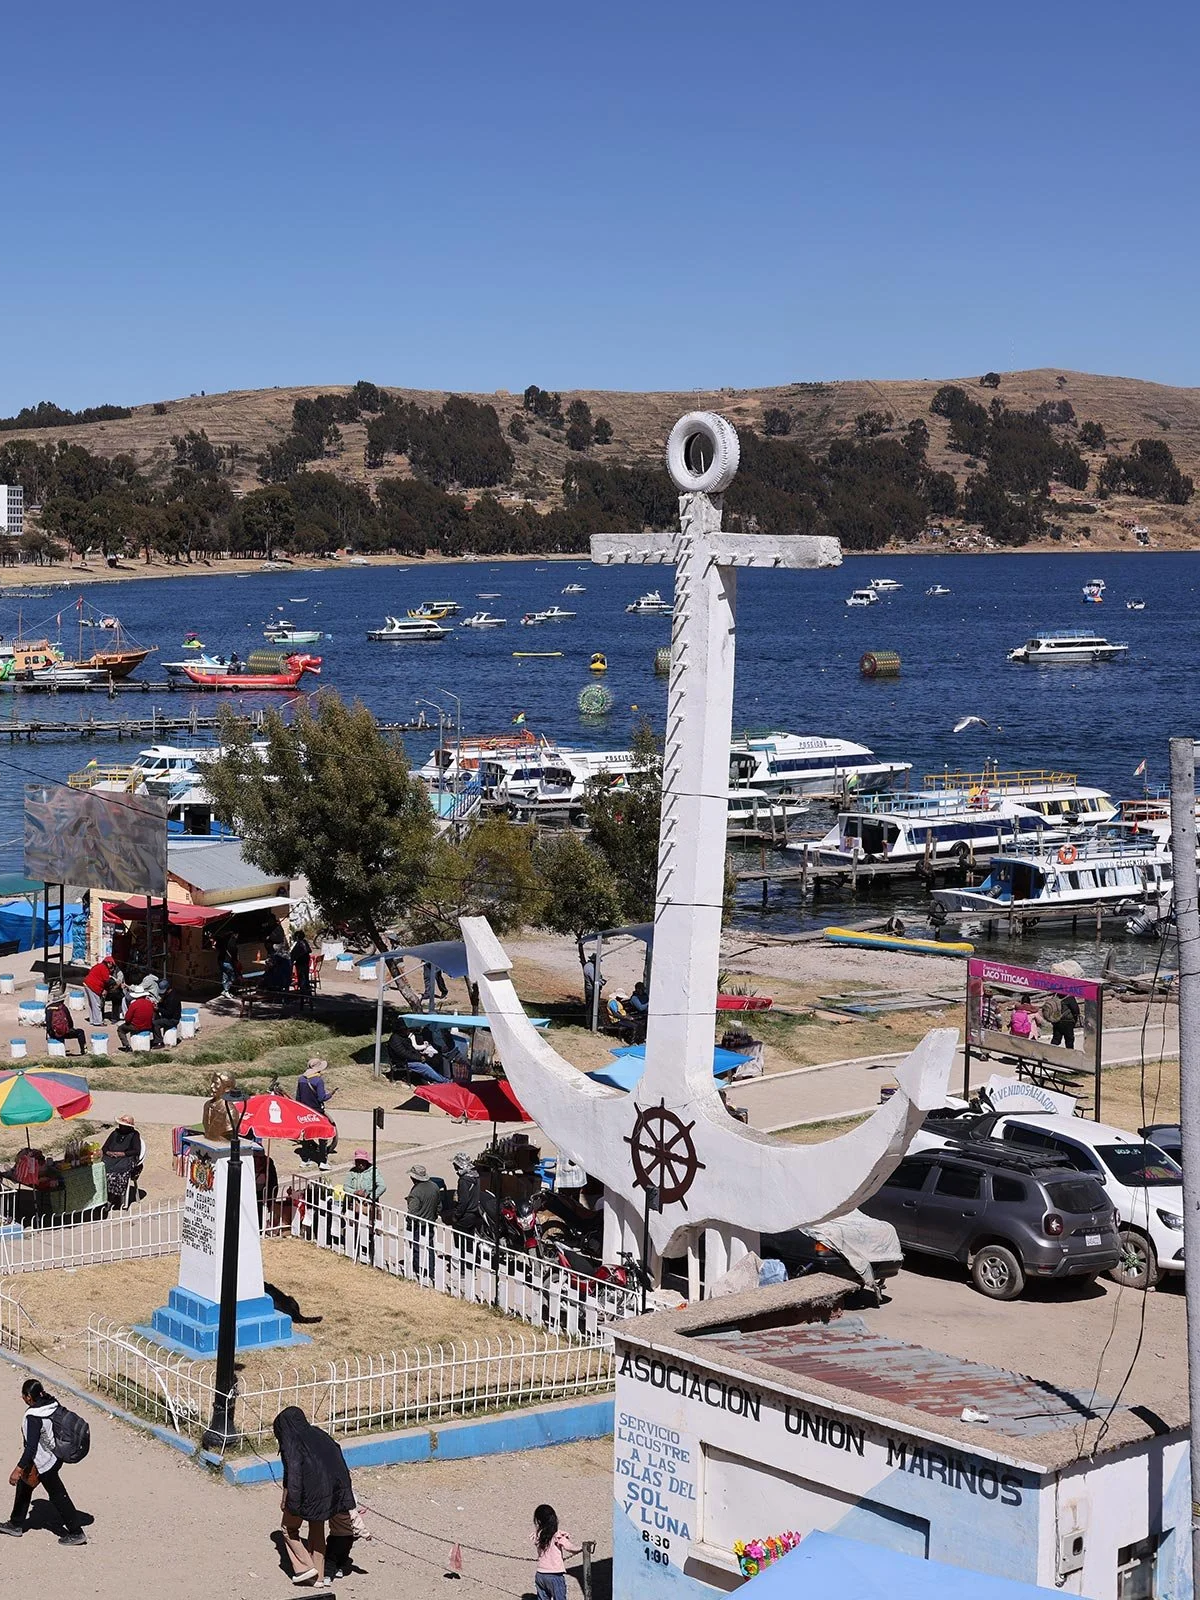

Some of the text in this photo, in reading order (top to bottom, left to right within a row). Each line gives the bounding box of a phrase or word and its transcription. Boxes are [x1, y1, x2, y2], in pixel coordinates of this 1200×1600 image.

[604, 754, 634, 762] POSEIDO
[799, 739, 827, 749] POSEIDON
[982, 969, 999, 980] LAGO
[618, 1350, 1023, 1507] ASOCIACION UNION MARINOS
[619, 1412, 680, 1444] SERVICIO
[618, 1427, 690, 1463] LACUSTRE
[630, 1448, 676, 1474] A LAS
[616, 1457, 696, 1500] ISLAS DEL
[627, 1481, 668, 1512] SOL
[623, 1500, 692, 1541] Y LUNA
[641, 1530, 670, 1550] 8:30
